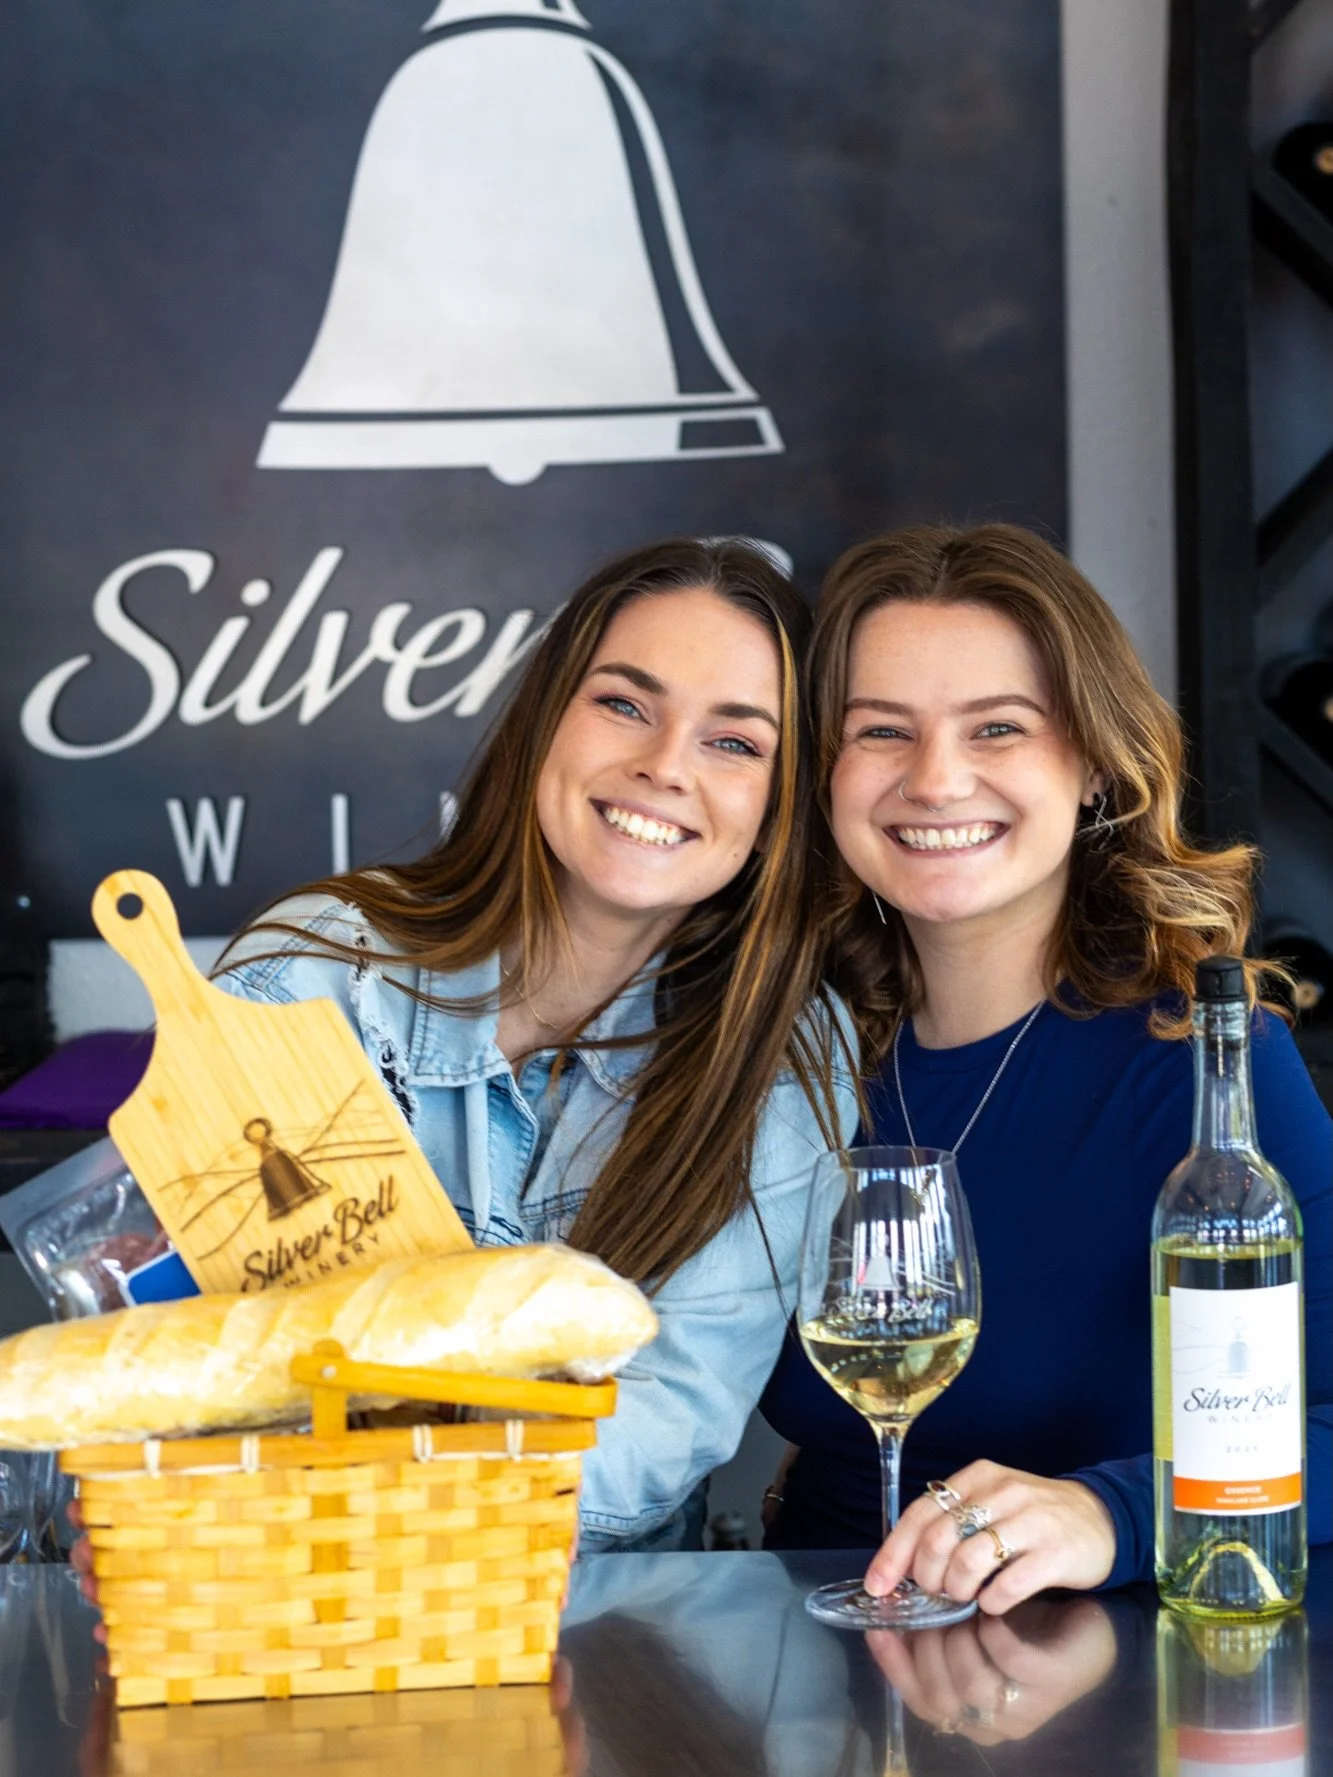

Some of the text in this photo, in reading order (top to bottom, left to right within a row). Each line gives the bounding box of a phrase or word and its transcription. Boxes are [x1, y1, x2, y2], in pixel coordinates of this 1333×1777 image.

[241, 1174, 399, 1293] Silver Bell
[1183, 1383, 1292, 1412] Silver Bell
